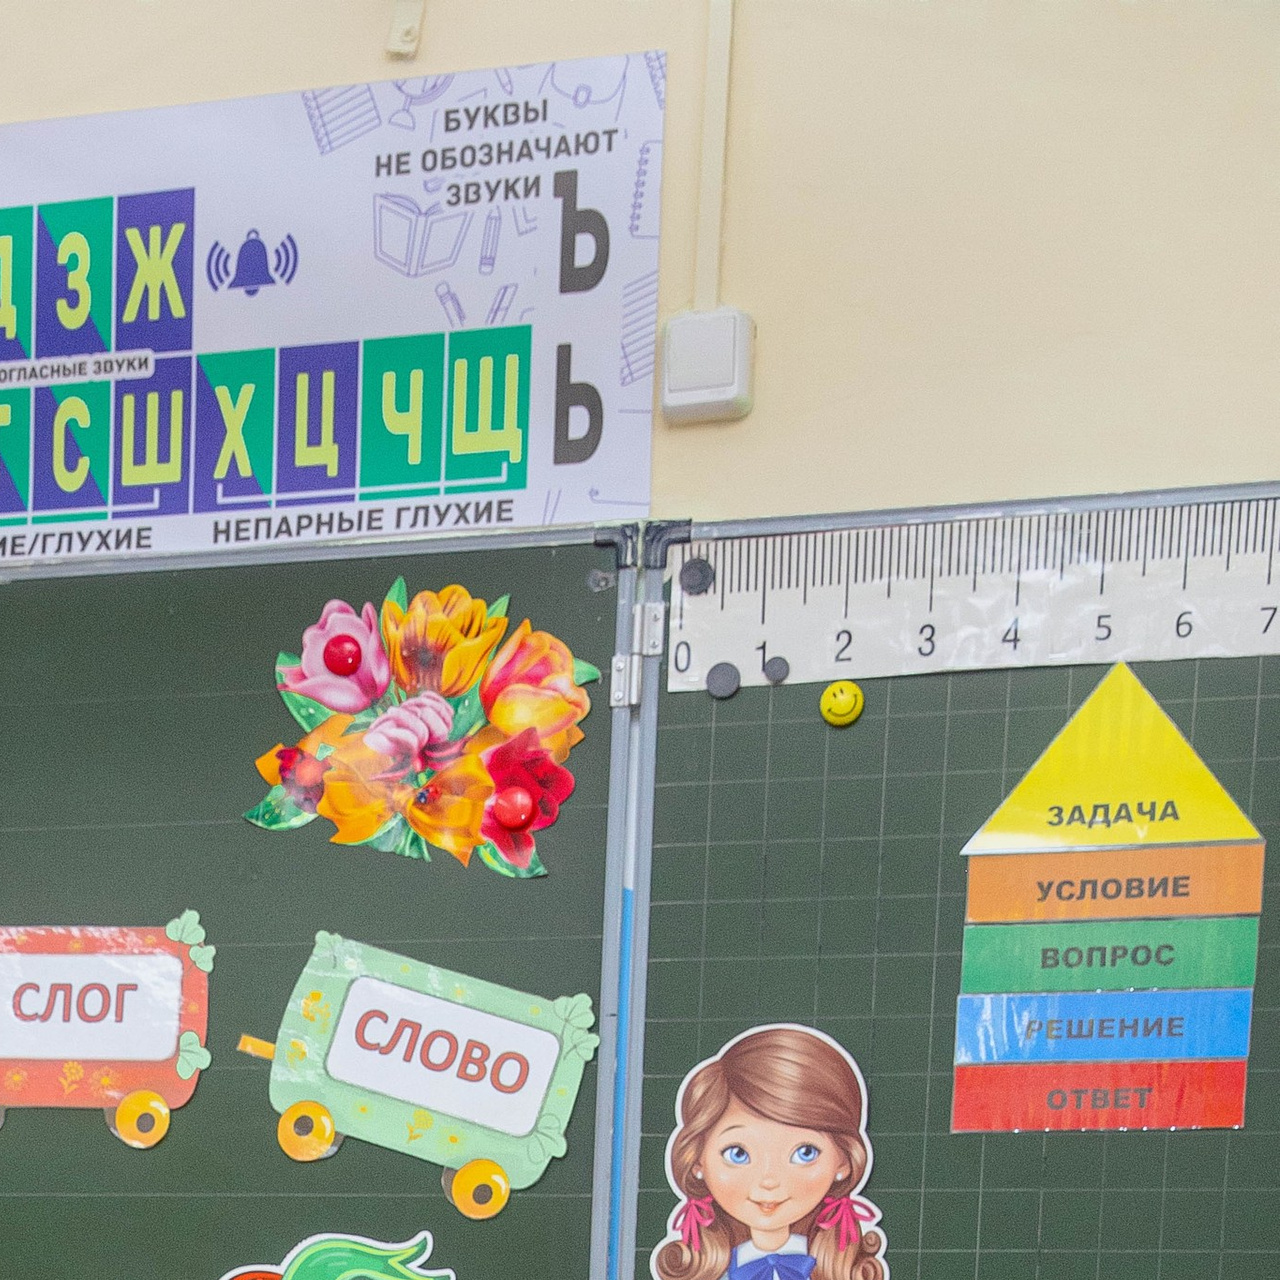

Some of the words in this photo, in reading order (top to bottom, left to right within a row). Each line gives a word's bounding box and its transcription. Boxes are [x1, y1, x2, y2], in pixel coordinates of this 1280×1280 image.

[443, 100, 549, 134] БУКВЫ
[374, 153, 412, 179] НЕ
[421, 129, 619, 174] ОБОЗНАЧАЮТ
[446, 176, 542, 208] ЗВУКИ
[553, 169, 611, 295] Ъ
[92, 356, 150, 376] ЗВУКИ
[552, 343, 604, 466] Ь
[213, 508, 385, 544] НЕПАРНЫЕ
[395, 498, 515, 530] ГЛУХИЕ
[673, 640, 692, 674] 0
[755, 640, 767, 672] 1
[835, 629, 854, 664] 2
[918, 623, 937, 657] 3
[1001, 618, 1021, 651] 4
[1095, 614, 1113, 641] 5
[1176, 611, 1193, 638] 6
[1260, 606, 1278, 634] 7
[1046, 799, 1181, 830] ЗАДАЧА
[1036, 875, 1191, 903] УСЛОВИЕ
[1040, 943, 1176, 970] ВОПРОС
[11, 982, 138, 1024] СЛОГ
[1024, 1016, 1186, 1041] РЕШЕНИЕ
[353, 1008, 531, 1095] СЛОВО
[1045, 1086, 1154, 1112] ОТВЕТ
